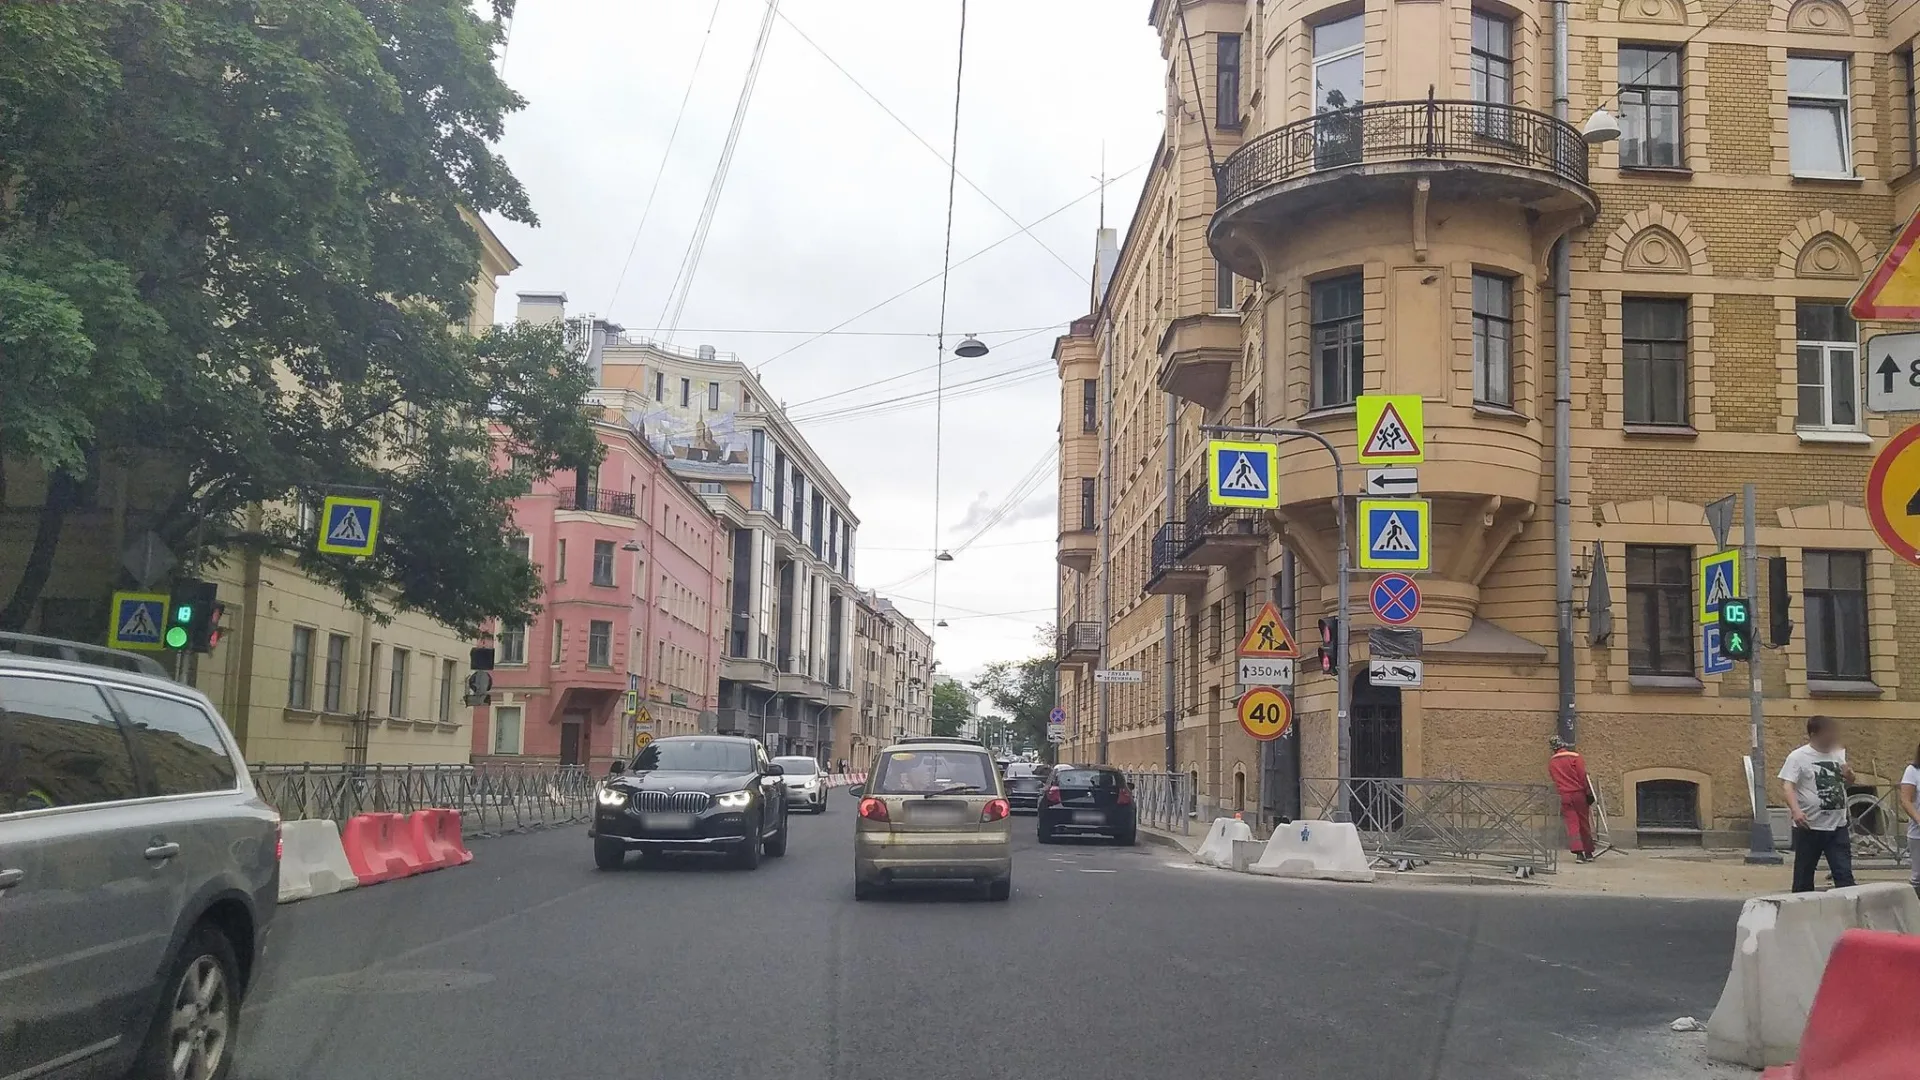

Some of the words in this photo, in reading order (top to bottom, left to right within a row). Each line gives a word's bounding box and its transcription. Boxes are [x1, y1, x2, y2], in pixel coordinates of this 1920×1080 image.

[178, 606, 192, 622] 18
[1726, 605, 1745, 622] 05
[1249, 703, 1280, 724] 40
